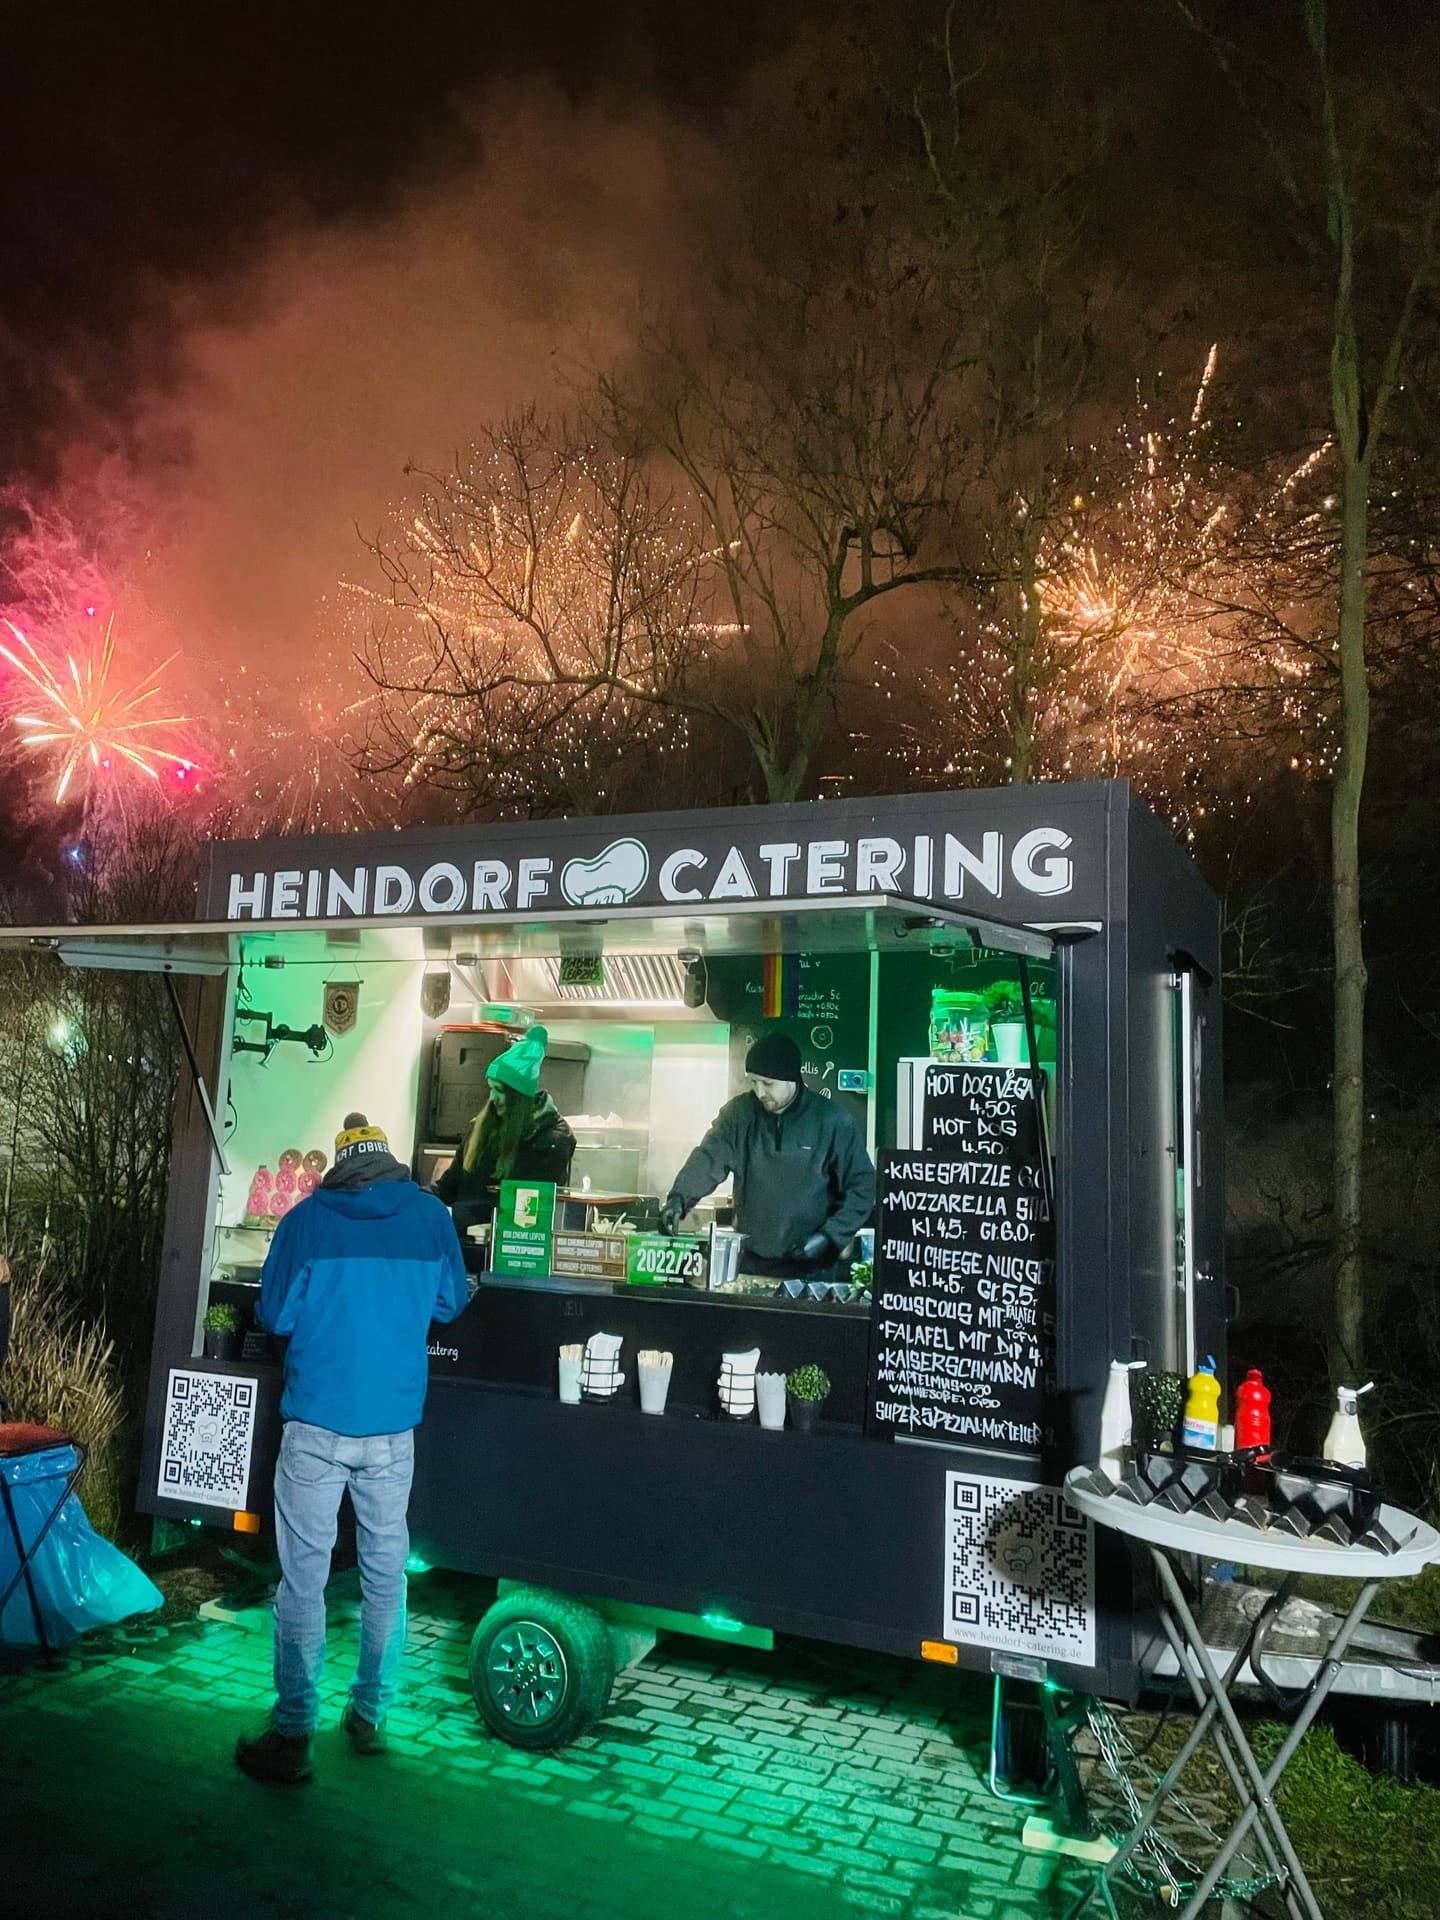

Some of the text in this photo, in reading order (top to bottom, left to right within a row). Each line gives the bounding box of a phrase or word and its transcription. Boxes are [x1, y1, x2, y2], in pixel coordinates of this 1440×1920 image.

[227, 827, 1073, 920] HEINDORF CATERING
[927, 1072, 960, 1097] HOT
[962, 1073, 993, 1098] DOG
[933, 1117, 1017, 1137] HOT DOG
[888, 1190, 1007, 1217] MOZZARELLA
[636, 1247, 703, 1277] 2022/23
[886, 1239, 920, 1265] CHILI
[924, 1245, 983, 1275] CHEESE
[882, 1293, 973, 1326] COUSCOUS
[884, 1320, 955, 1351] FALAFEL
[959, 1330, 992, 1353] MIT
[993, 1335, 1023, 1361] DIP
[884, 1347, 1037, 1390] KAISERSCHMARRN
